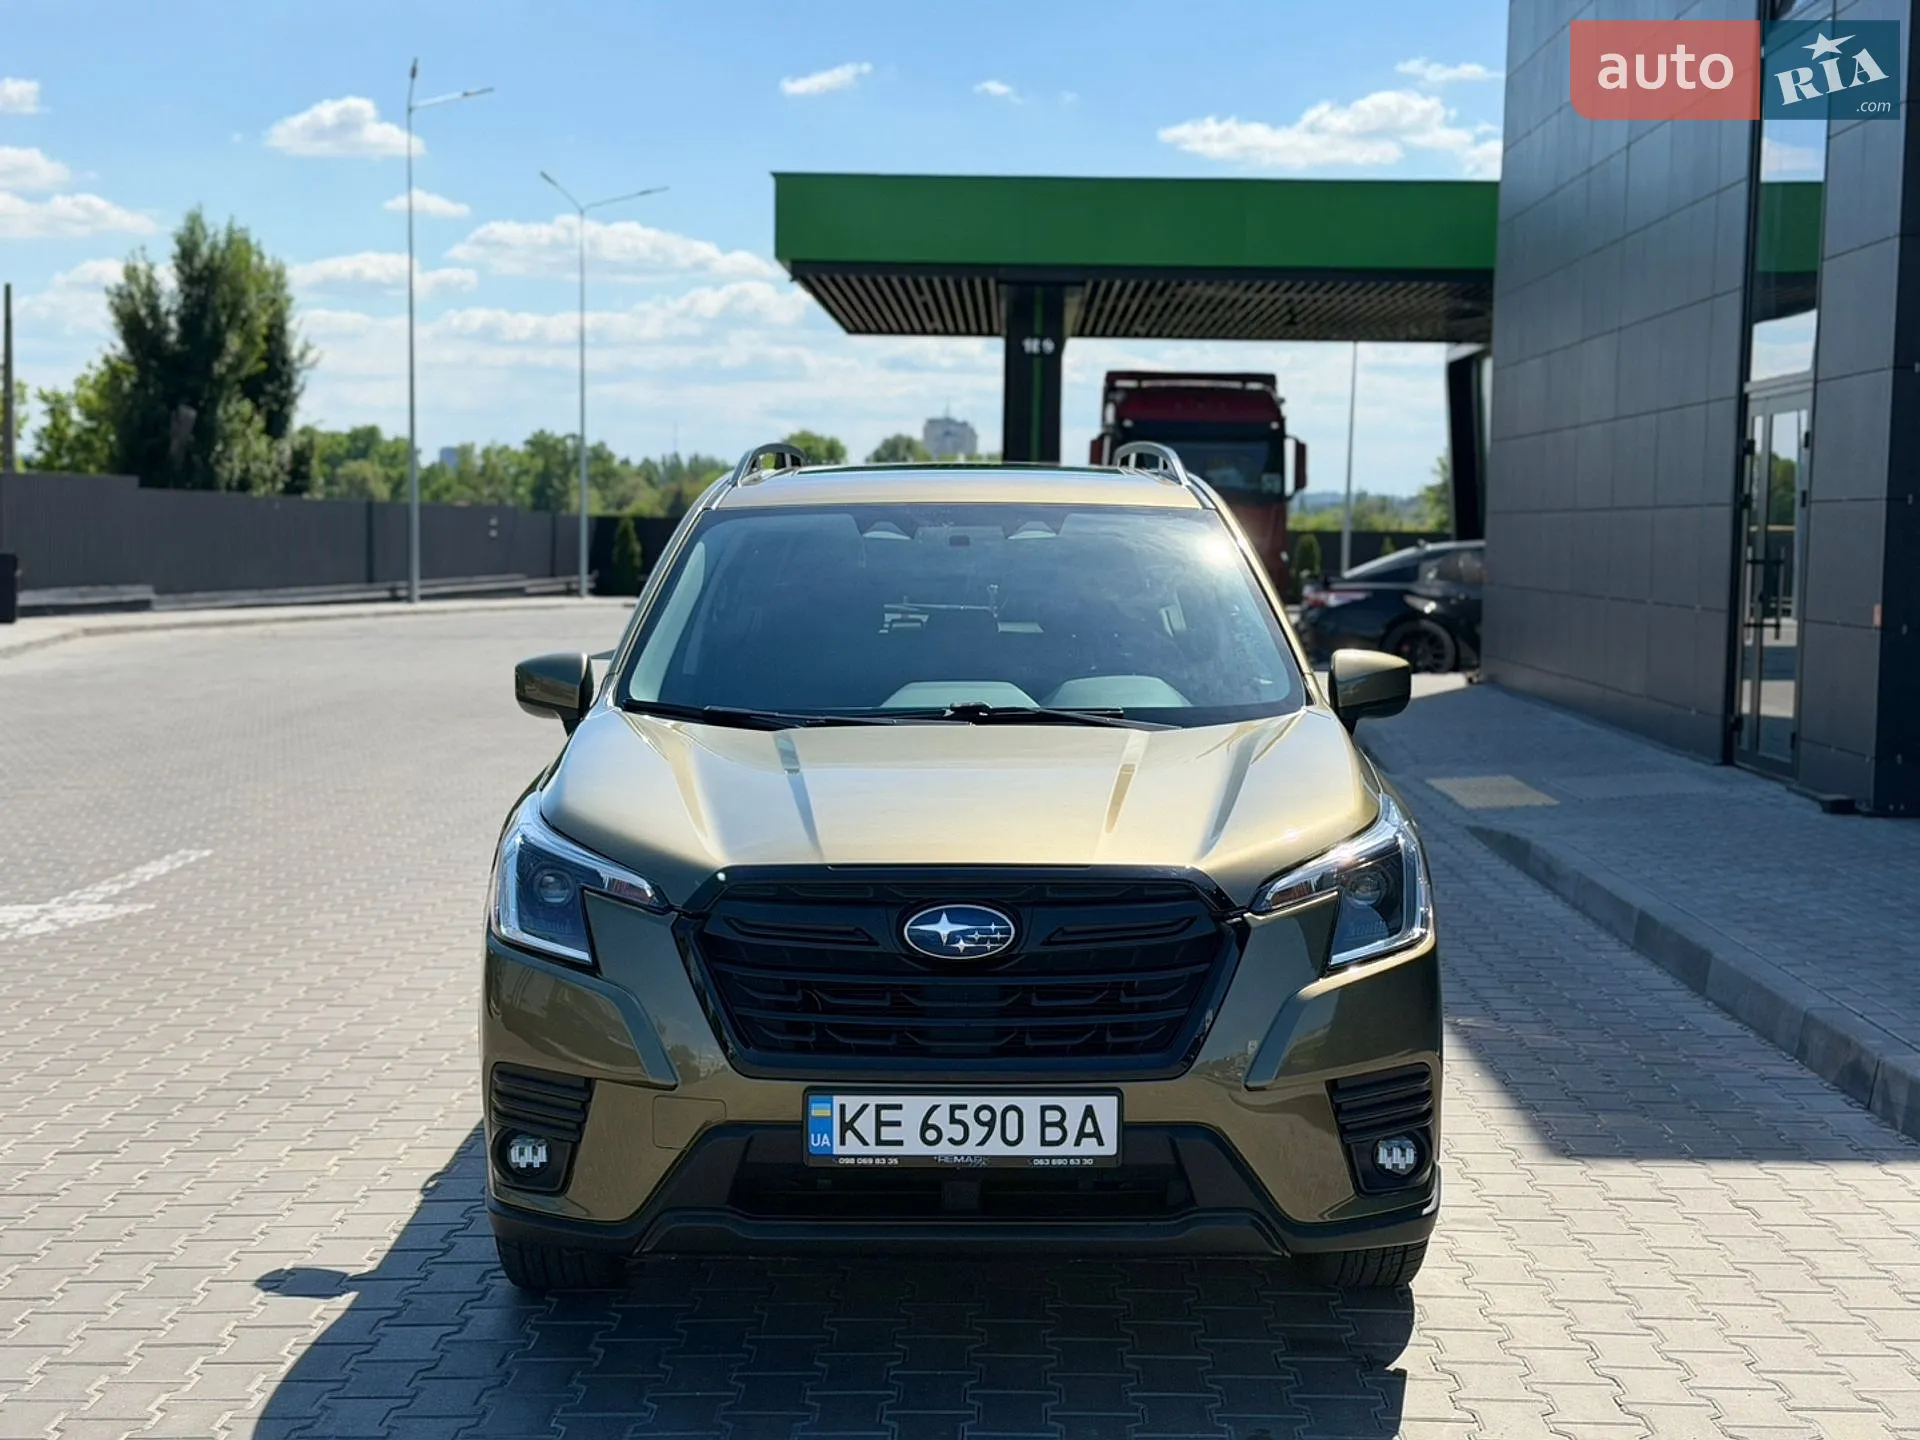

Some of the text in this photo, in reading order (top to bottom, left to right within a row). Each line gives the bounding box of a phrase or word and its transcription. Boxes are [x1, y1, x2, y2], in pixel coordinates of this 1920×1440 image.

[838, 1103, 1105, 1147] KE 6590 BA
[811, 1134, 831, 1147] UA
